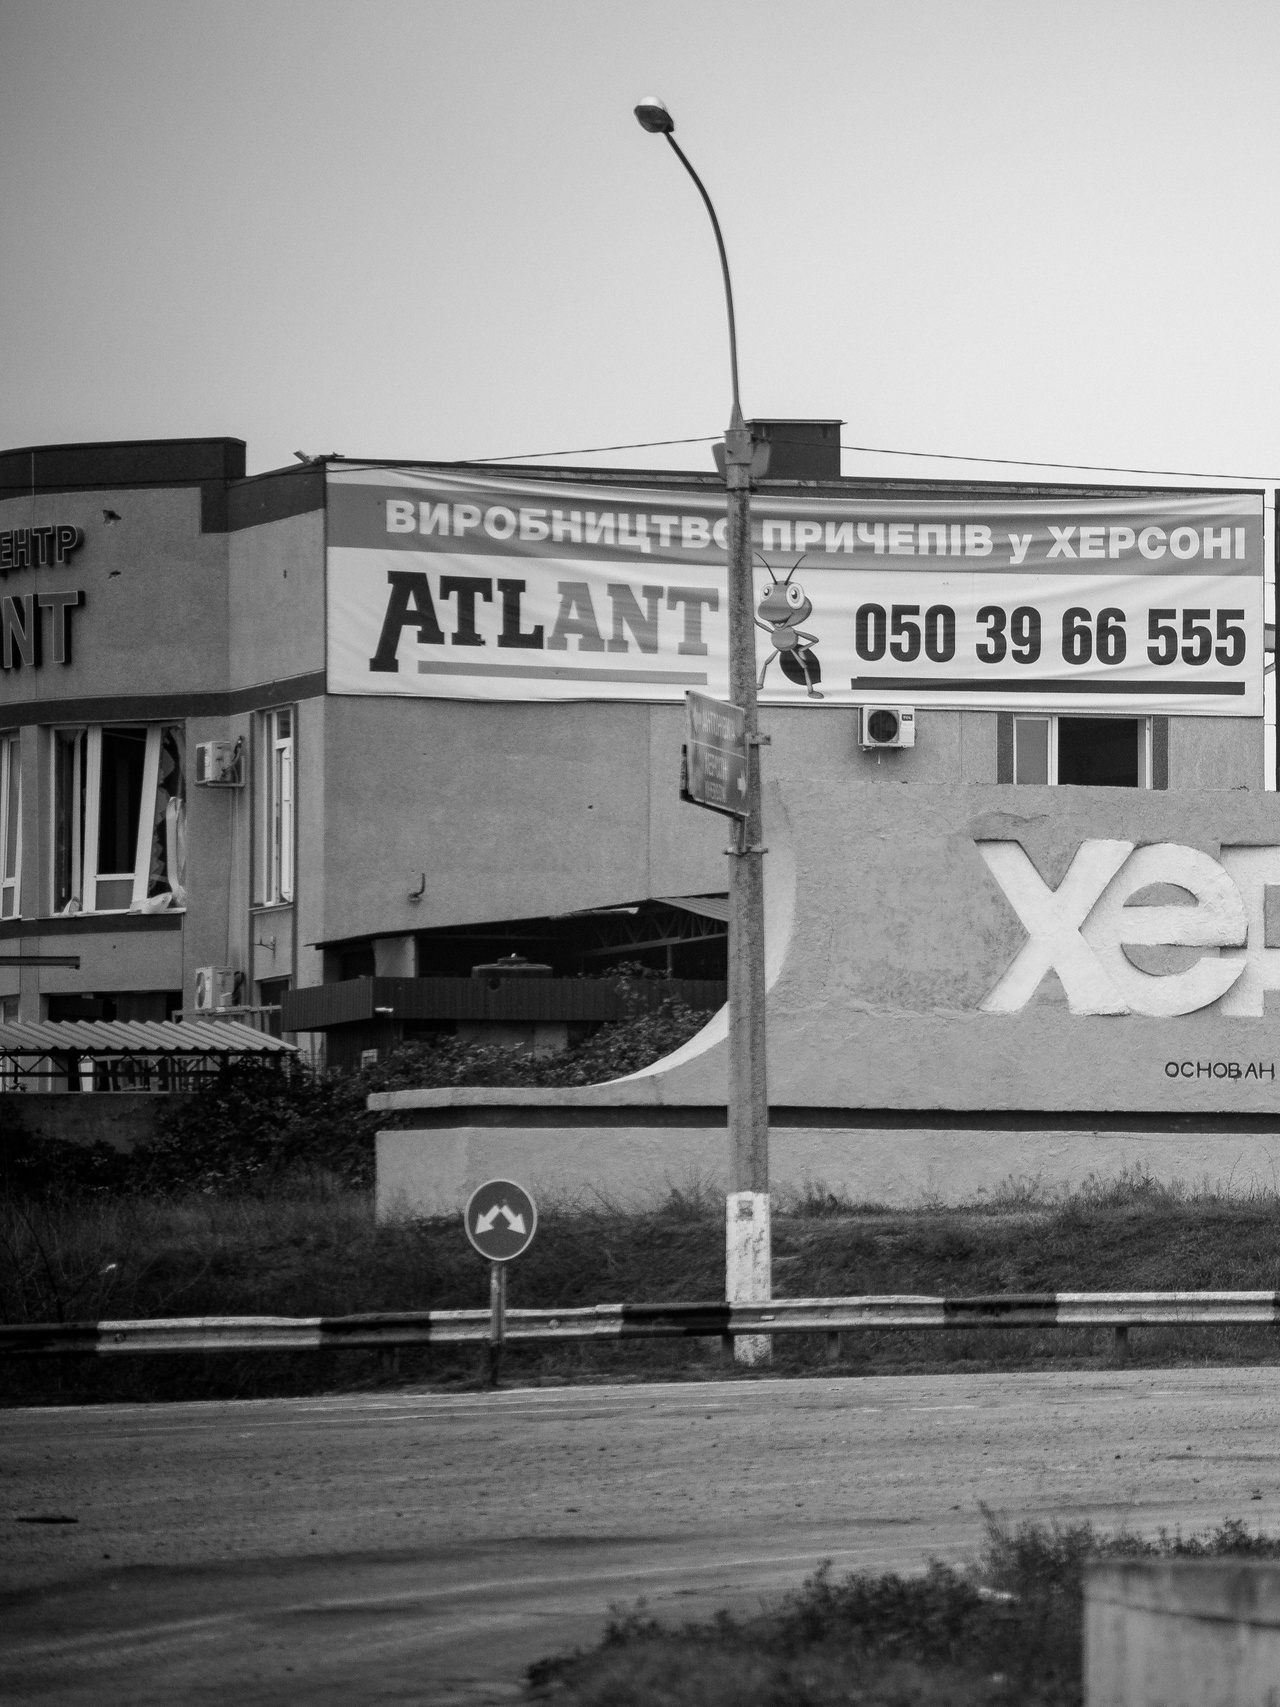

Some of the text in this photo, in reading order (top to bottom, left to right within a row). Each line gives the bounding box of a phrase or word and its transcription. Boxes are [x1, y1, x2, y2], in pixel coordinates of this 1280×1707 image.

[762, 519, 993, 557] ПРИЧЕПІВ
[1009, 533, 1033, 565] у
[1046, 526, 1246, 560] ХЕРСОНІ
[369, 570, 719, 673] ATLANT
[855, 603, 1246, 667] 050 39 66 555
[1165, 1061, 1275, 1080] ОСНОВАН
